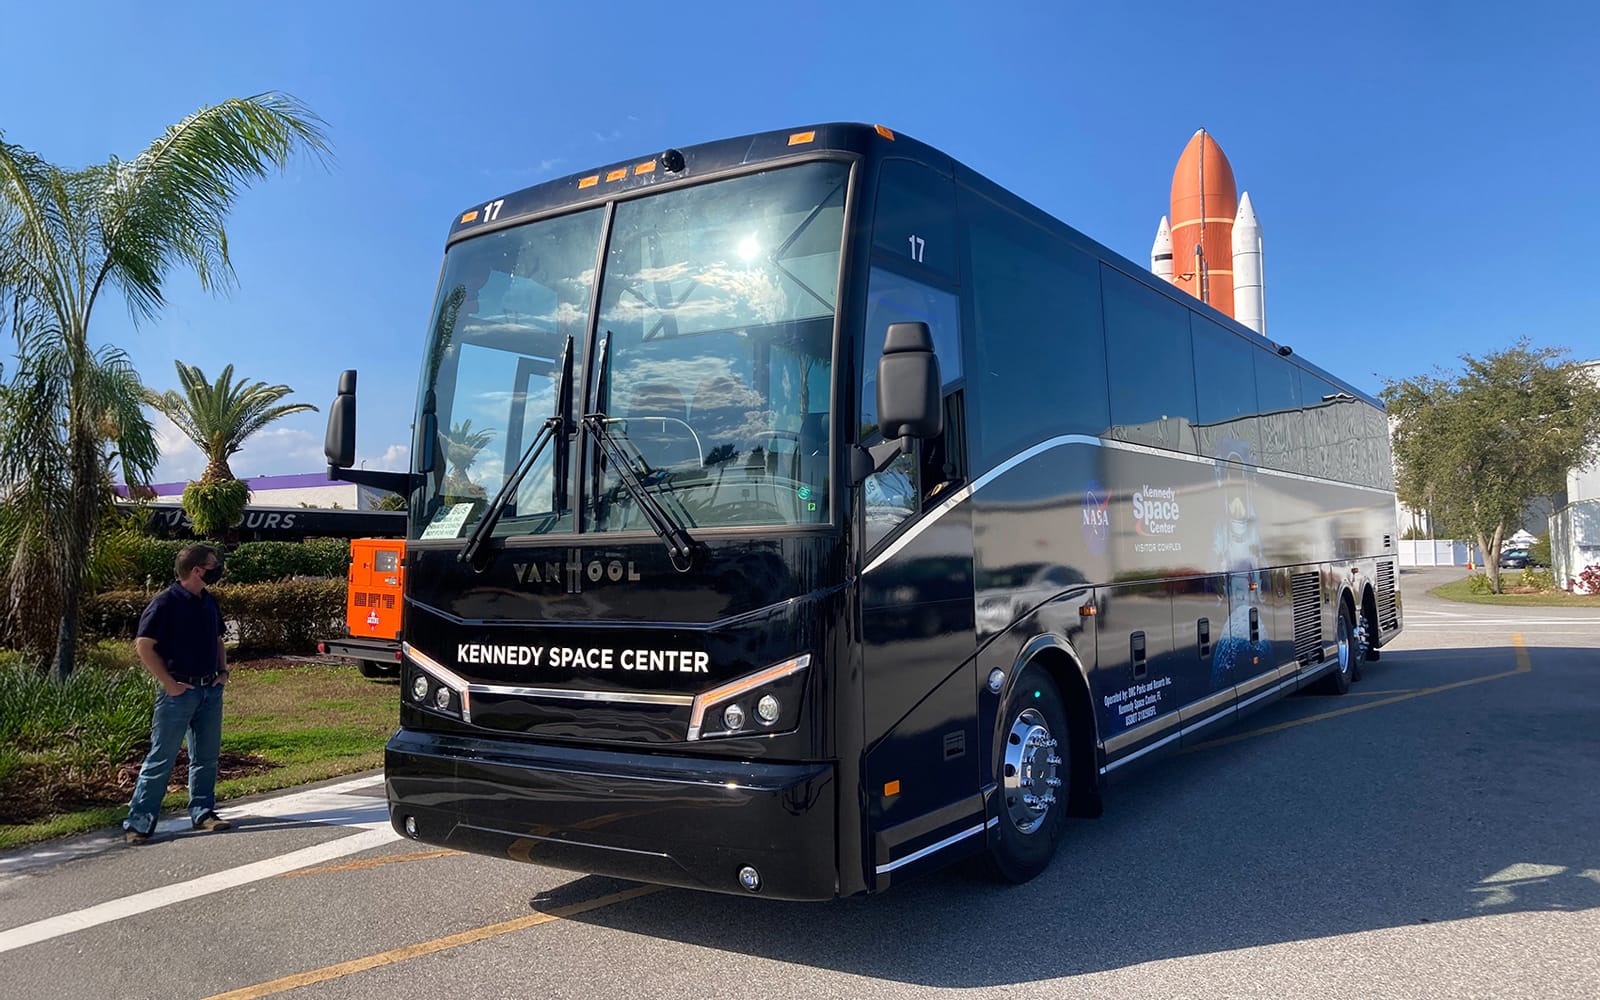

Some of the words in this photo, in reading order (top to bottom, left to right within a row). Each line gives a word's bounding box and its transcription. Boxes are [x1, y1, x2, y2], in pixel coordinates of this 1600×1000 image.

[483, 199, 505, 223] 17
[908, 234, 925, 263] 17
[1142, 484, 1176, 501] Kennedy
[1083, 509, 1109, 525] NASA
[1133, 492, 1180, 525] Space
[1149, 520, 1176, 533] Center
[1134, 543, 1157, 552] VISITOR
[1158, 543, 1182, 552] COMPLEX
[457, 644, 544, 666] KENNEDY
[549, 647, 613, 669] SPACE
[620, 650, 709, 673] CENTER
